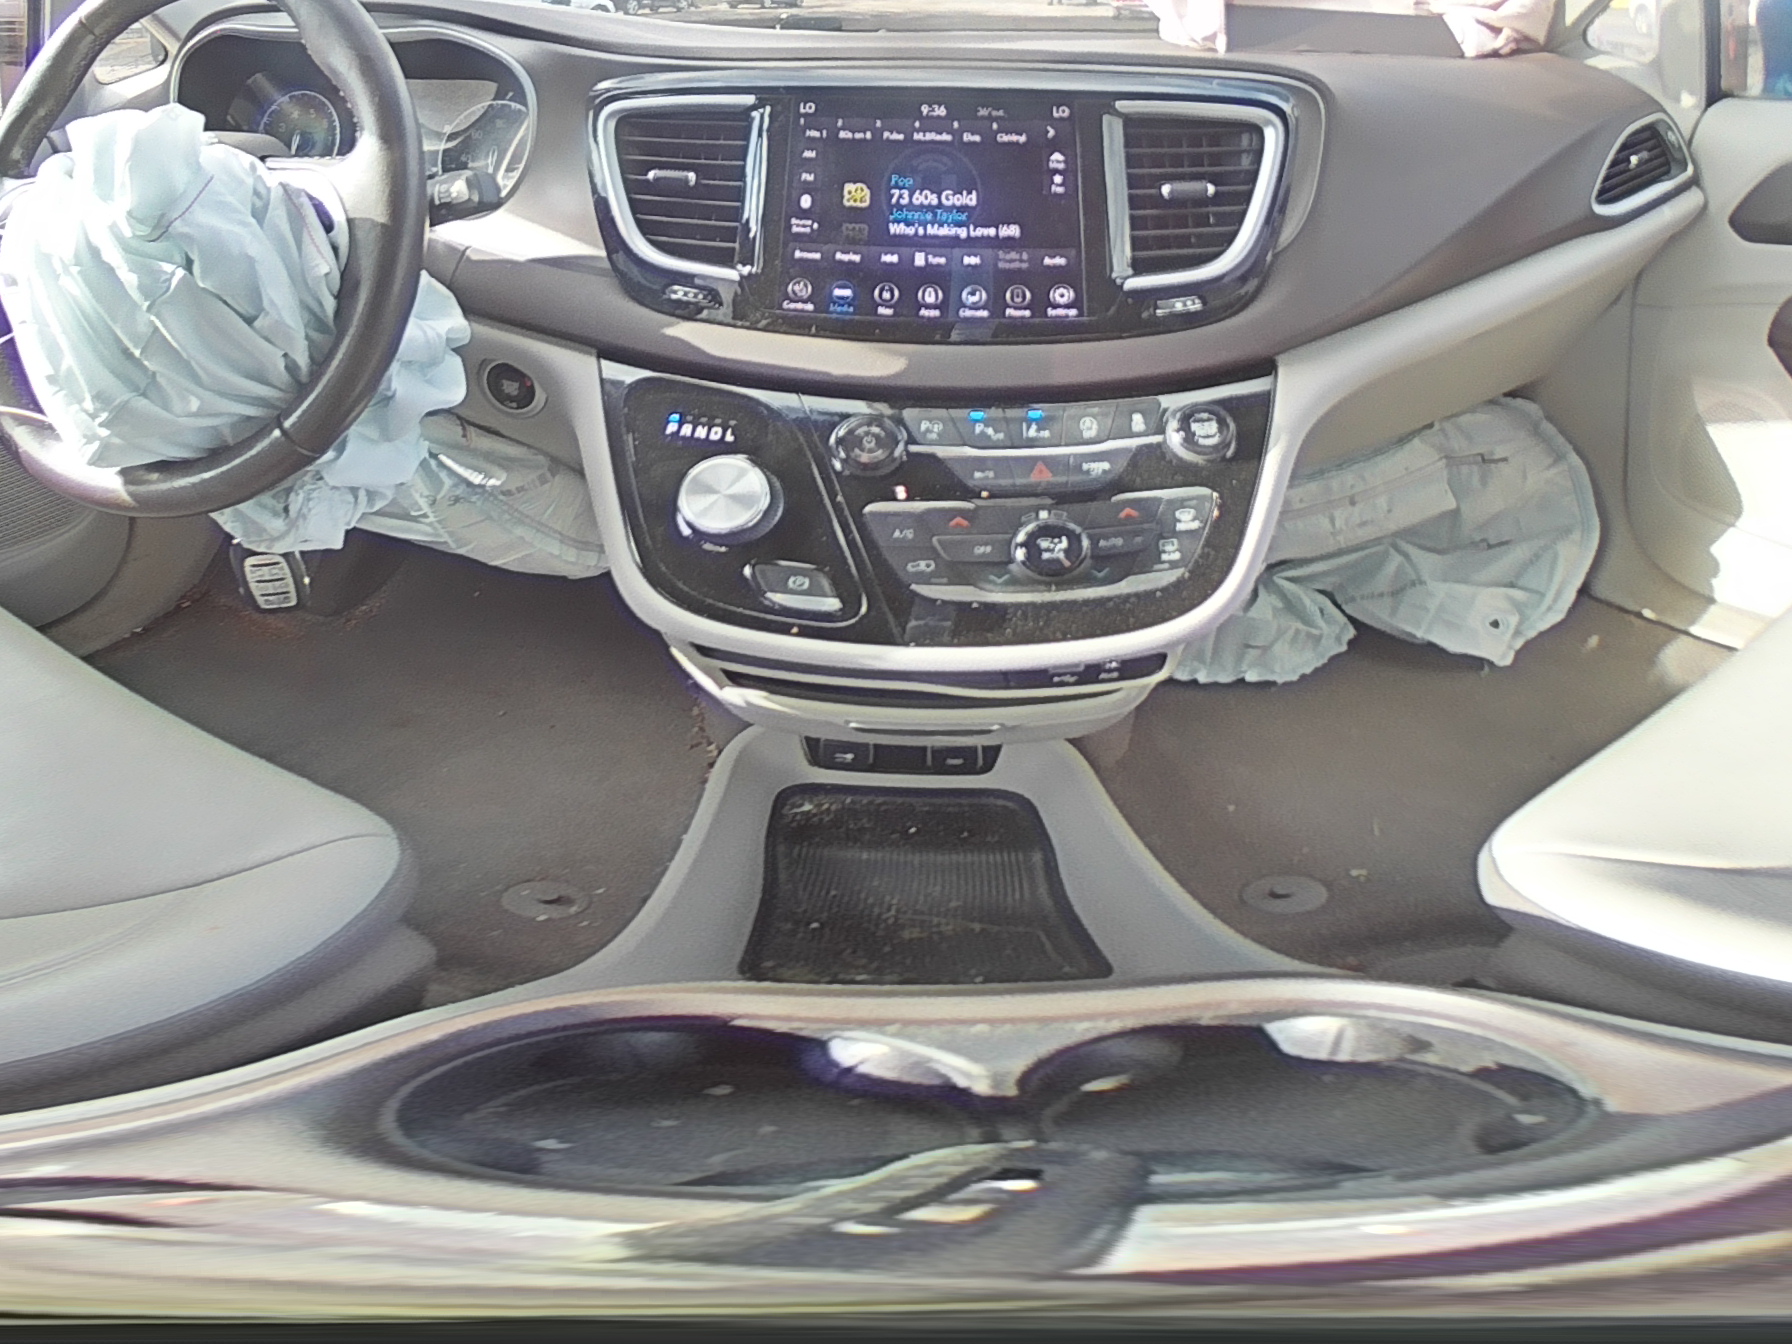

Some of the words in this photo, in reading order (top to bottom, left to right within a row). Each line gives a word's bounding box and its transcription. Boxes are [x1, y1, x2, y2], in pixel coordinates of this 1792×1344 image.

[799, 102, 816, 114] LO
[920, 104, 947, 117] 9:36
[1052, 105, 1071, 118] LO
[890, 174, 914, 187] Pop
[890, 189, 910, 205] 73
[912, 189, 939, 206] 60s
[941, 189, 978, 207] Gold
[889, 208, 933, 222] Johnnie
[935, 209, 968, 224] Taylor
[888, 221, 925, 236] Who's
[926, 222, 968, 239] Making
[969, 223, 997, 238] Love
[893, 528, 914, 540] A/C
